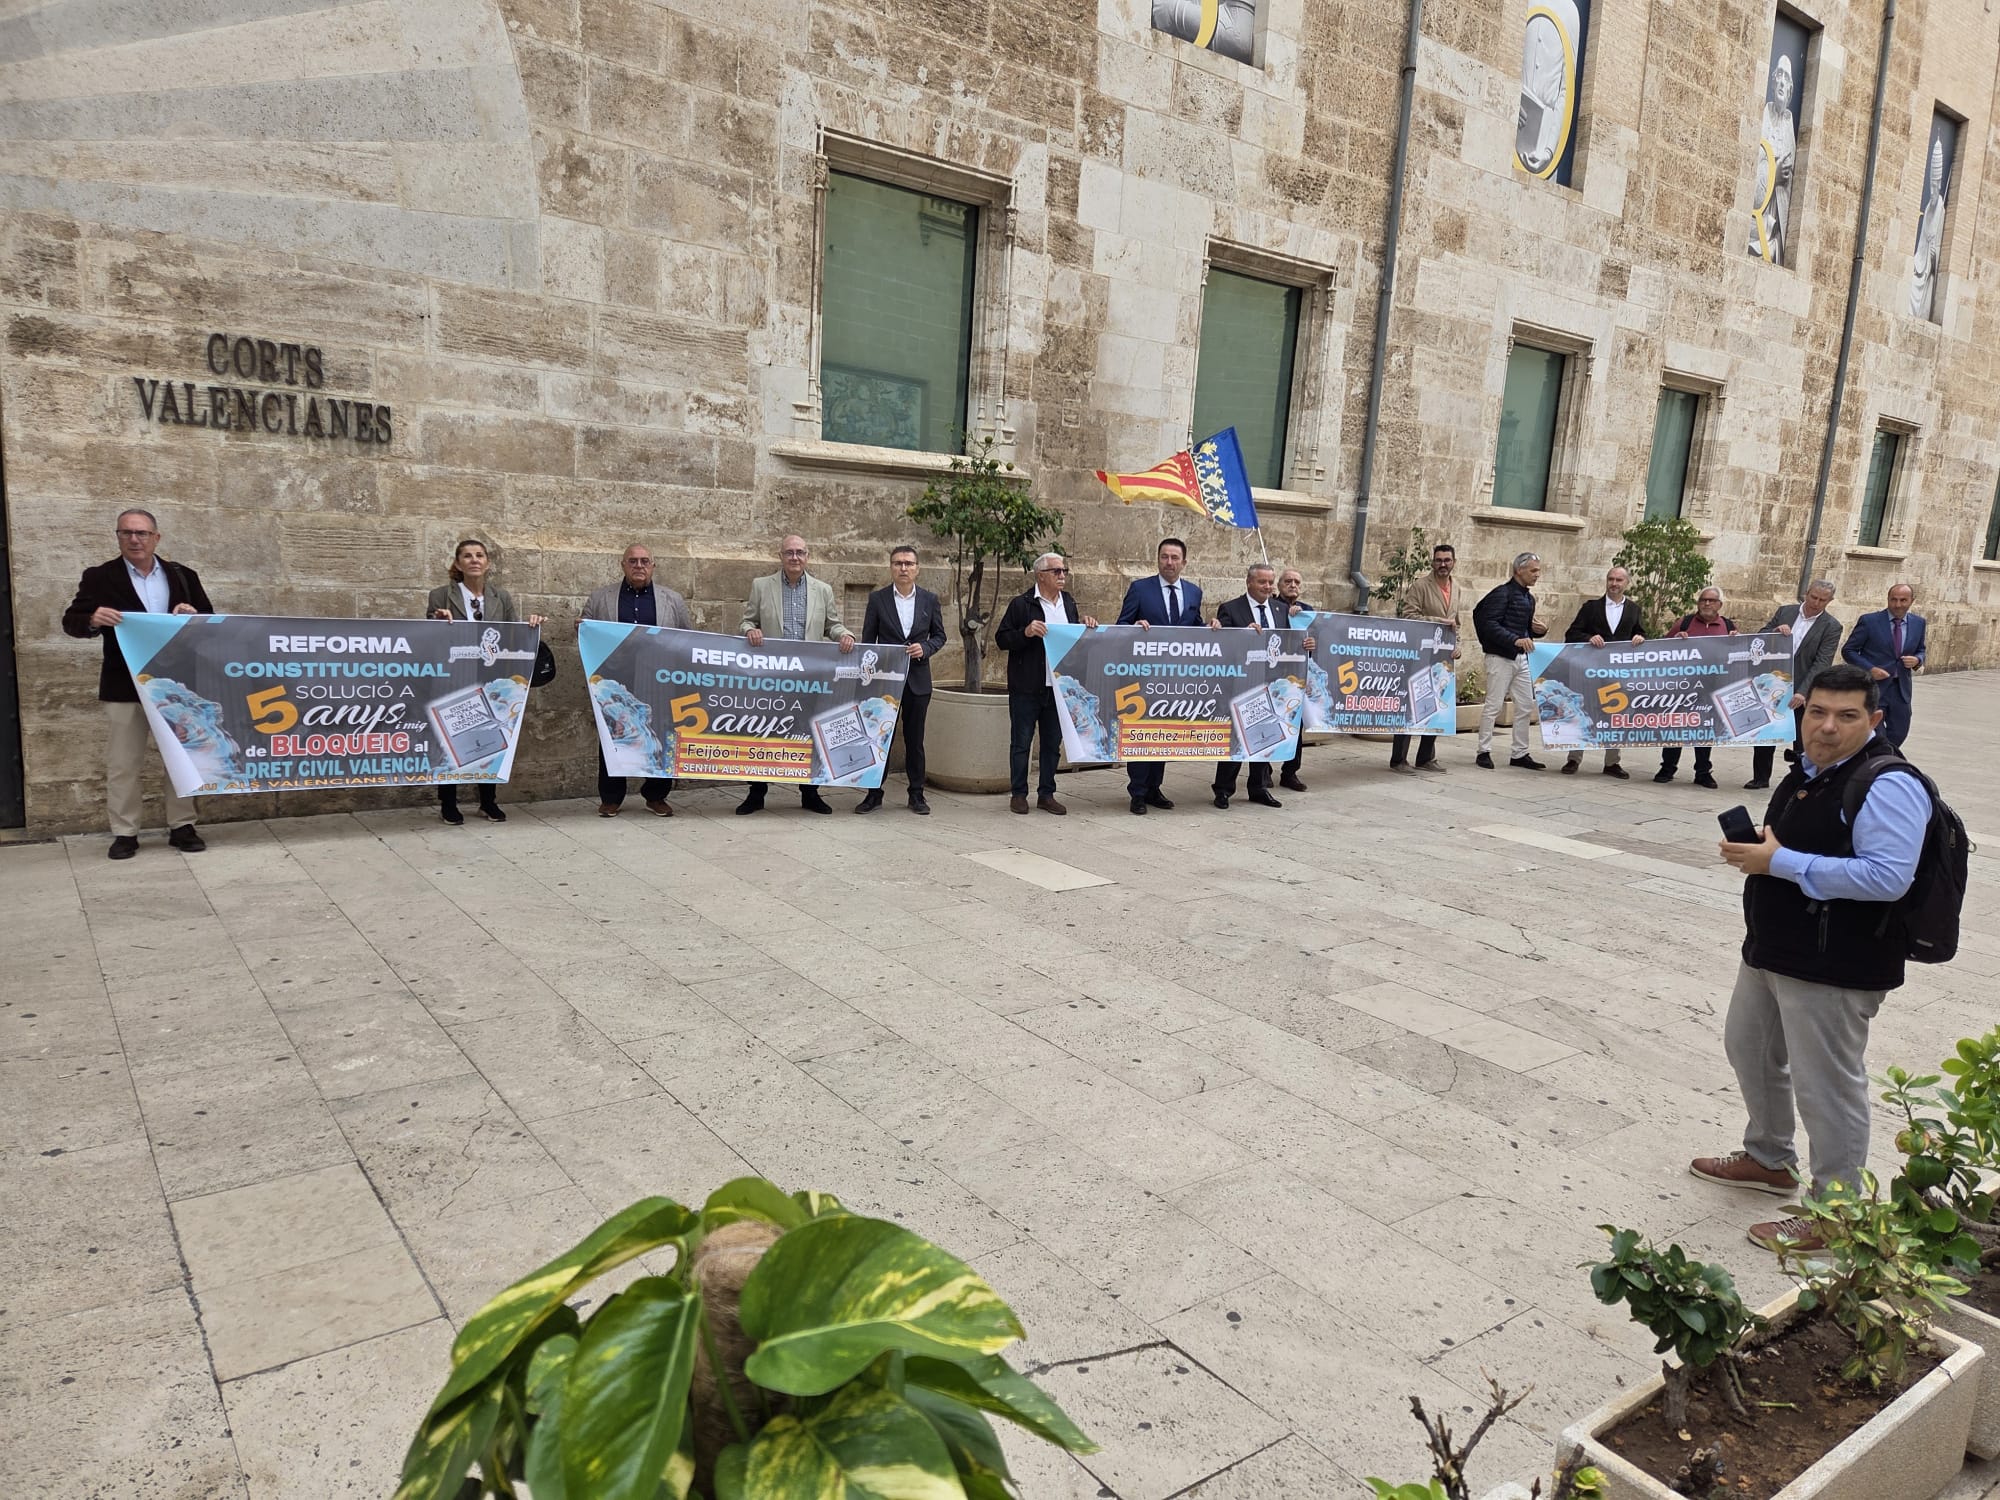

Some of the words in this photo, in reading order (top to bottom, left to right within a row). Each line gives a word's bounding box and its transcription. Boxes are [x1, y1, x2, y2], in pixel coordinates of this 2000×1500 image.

[207, 333, 323, 388] CORTS
[133, 377, 392, 443] VALENCIANES
[1348, 627, 1407, 643] REFORMA
[269, 635, 412, 654] REFORMA
[1133, 641, 1222, 657] REFORMA
[1329, 644, 1420, 660] CONSTITUCIONAL
[692, 647, 805, 672] REFORMA
[1610, 649, 1702, 664] REFORMA
[224, 661, 450, 678] CONSTITUCIONAL
[1104, 663, 1247, 677] CONSTITUCIONAL
[1357, 661, 1398, 673] SOLUCIÓ
[1399, 666, 1406, 674] A
[1585, 665, 1728, 679] CONSTITUCIONAL
[655, 669, 833, 694] CONSTITUCIONAL
[1145, 680, 1209, 695] SOLUCIÓ
[1212, 684, 1223, 695] A
[1338, 661, 1358, 695] 5
[1359, 676, 1401, 697] anys
[1626, 678, 1690, 691] SOLUCIÓ
[1694, 680, 1704, 689] A
[295, 681, 394, 699] SOLUCIÓ
[399, 685, 415, 698] A
[1597, 682, 1629, 714] 5
[1631, 692, 1698, 715] anys
[246, 685, 298, 734] 5
[302, 702, 406, 735] anys
[395, 721, 401, 730] i
[402, 721, 428, 733] mig
[707, 694, 786, 711] SOLUCIÓ
[790, 700, 803, 711] A
[1115, 682, 1147, 721] 5
[1148, 699, 1216, 722] anys
[1335, 702, 1344, 711] de
[1345, 695, 1400, 712] BLOQUEIG
[1401, 704, 1407, 712] al
[670, 692, 709, 735] 5
[711, 713, 794, 739] anys
[790, 733, 811, 742] mig
[1334, 714, 1352, 726] DRET
[1355, 714, 1373, 726] CIVIL
[1596, 720, 1609, 729] de
[1611, 712, 1700, 729] BLOQUEIG
[1703, 718, 1714, 726] al
[1130, 729, 1178, 741] Sánchez
[1182, 730, 1186, 741] i
[1189, 730, 1224, 744] Feijóo
[1596, 731, 1625, 742] DRET
[1628, 729, 1657, 741] CIVIL
[1661, 727, 1716, 741] VALENCIÀ
[245, 743, 266, 758] de
[271, 732, 410, 757] BLOQUEIG
[414, 741, 428, 752] al
[687, 744, 730, 761] Feijóo
[735, 746, 739, 759] i
[748, 747, 805, 762] Sánchez
[1123, 747, 1149, 755] SENTIU
[1151, 747, 1157, 755] A
[1160, 747, 1171, 755] LES
[1174, 746, 1225, 755] VALENCIANES
[245, 761, 293, 779] DRET
[298, 758, 344, 777] CIVIL
[349, 753, 432, 775] VALENCIÀ
[683, 762, 719, 773] SENTIU
[721, 765, 740, 775] ALS
[744, 766, 808, 777] VALENCIANS
[224, 780, 260, 791] ALS
[267, 775, 387, 788] VALENCIANS
